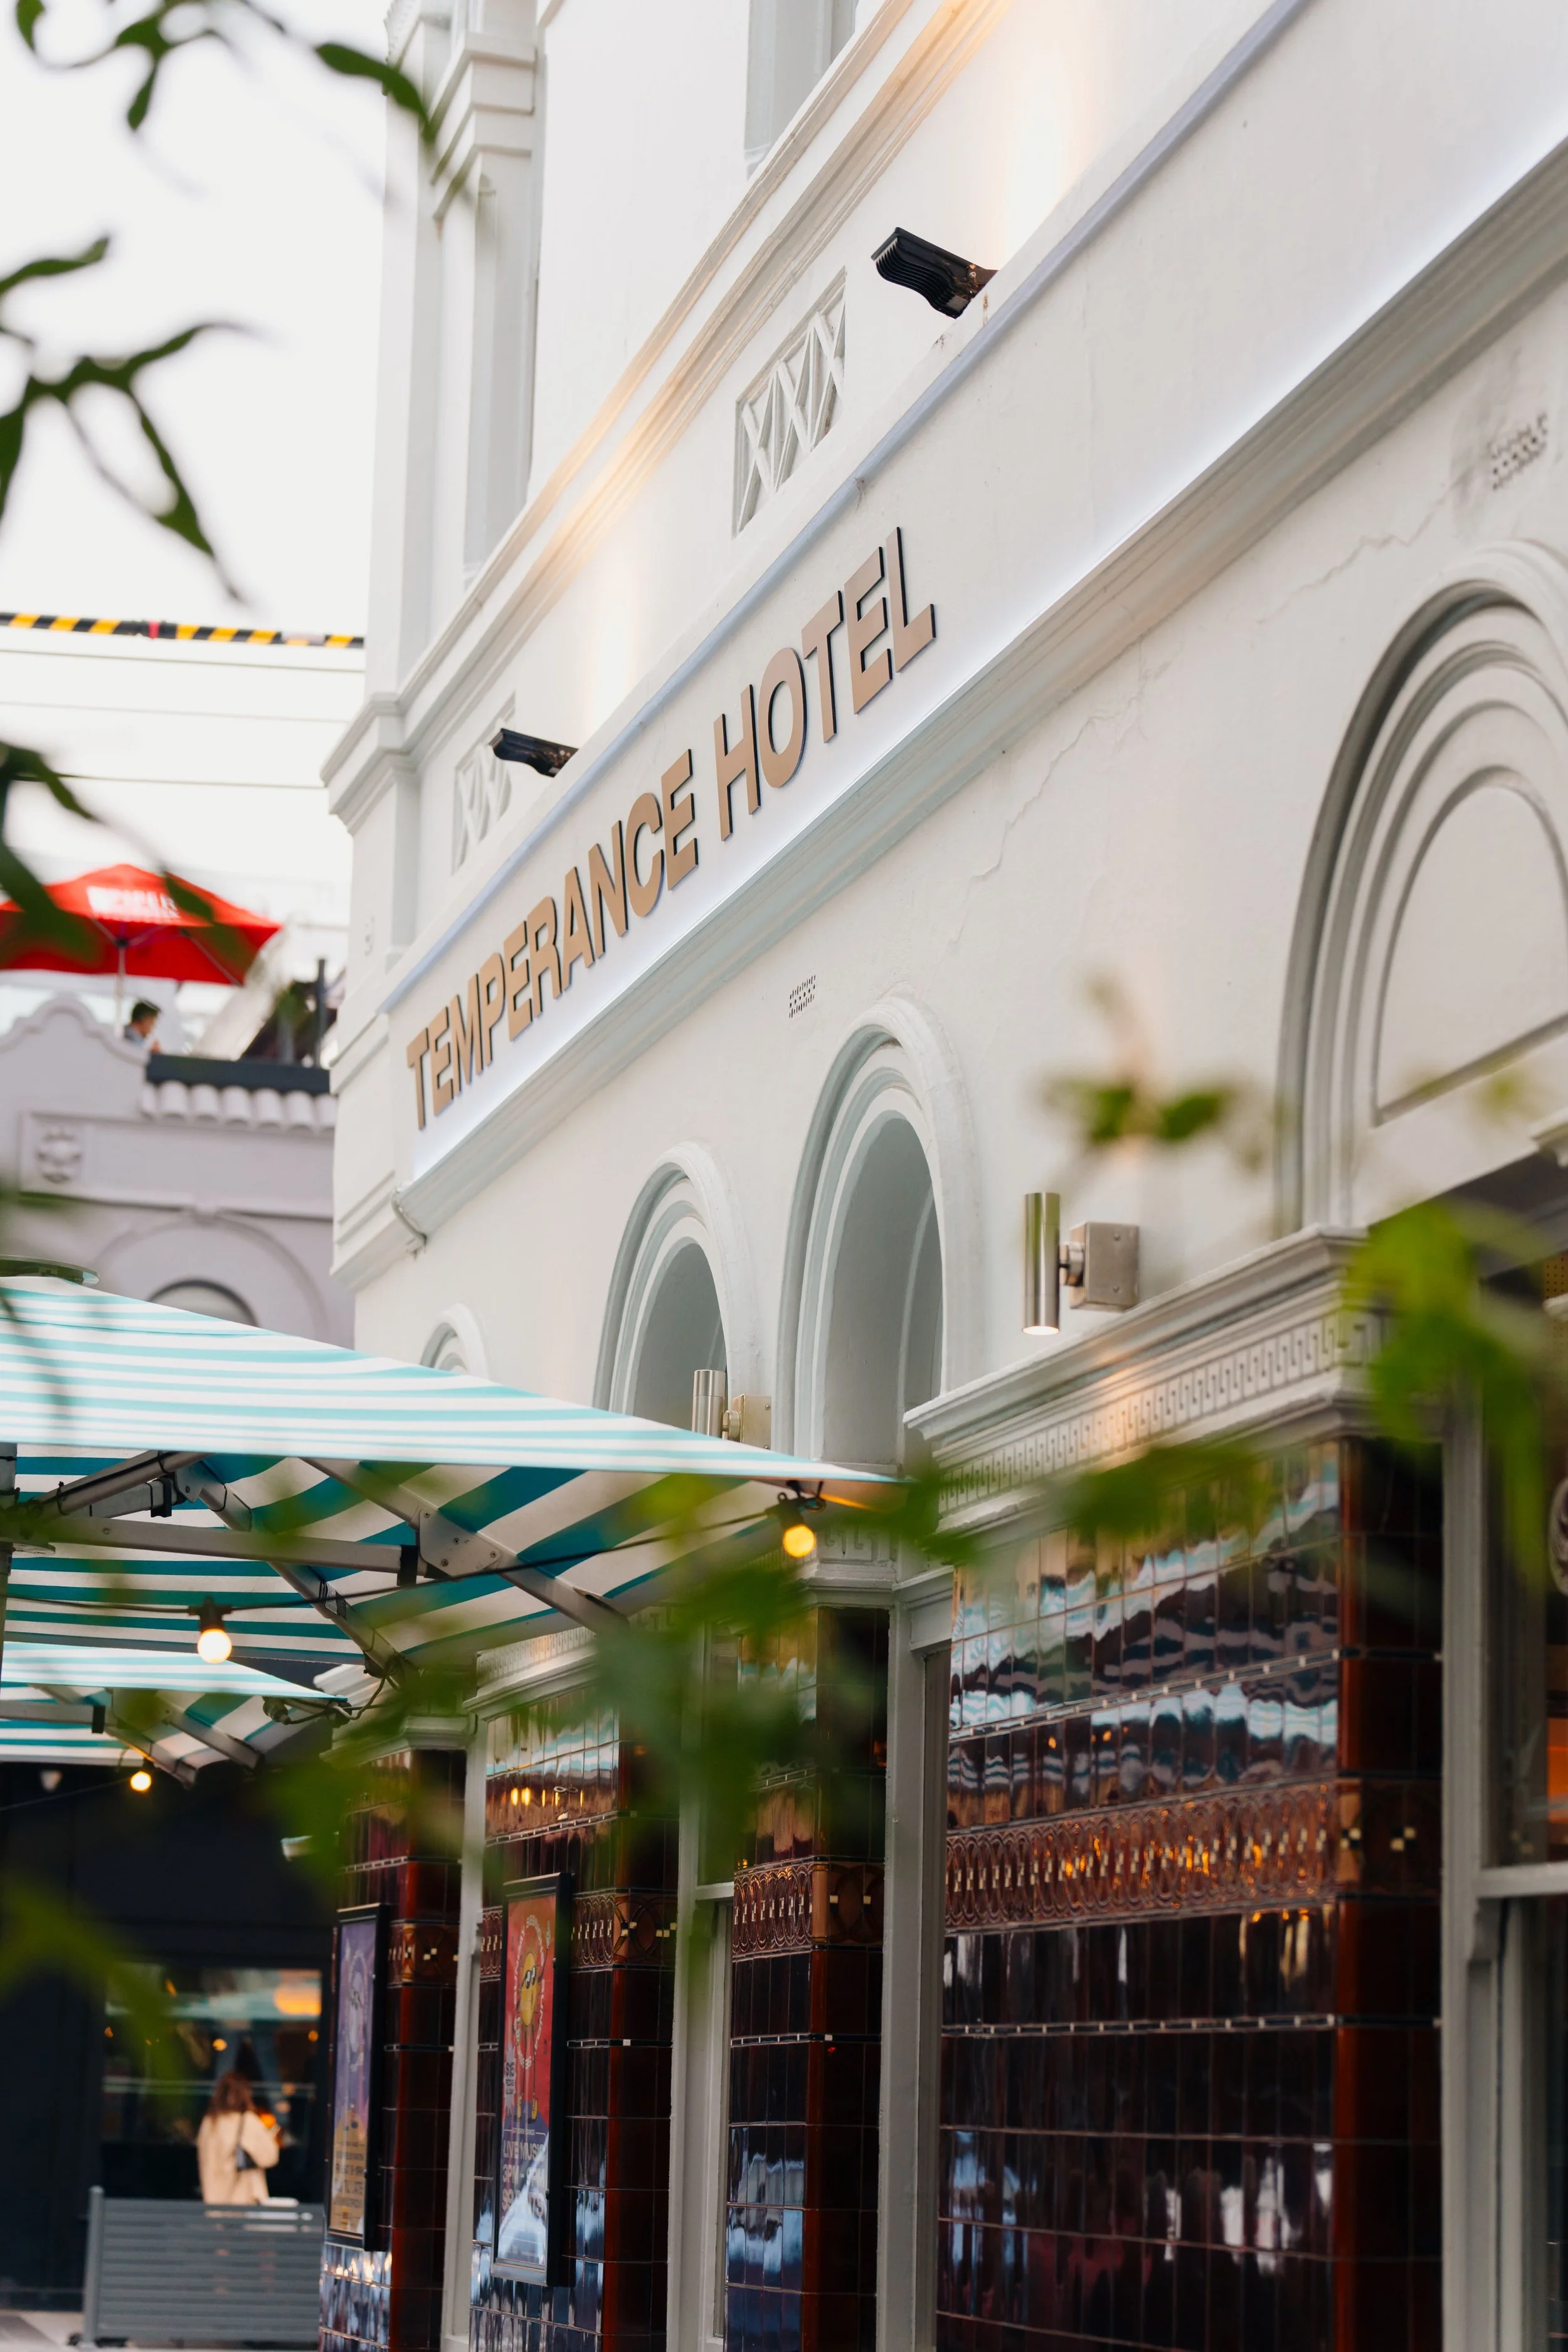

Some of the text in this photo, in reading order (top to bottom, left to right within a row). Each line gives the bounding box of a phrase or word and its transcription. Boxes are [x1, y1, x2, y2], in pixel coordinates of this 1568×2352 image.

[407, 526, 936, 1131] TEMPERANCE HOTEL
[503, 2140, 520, 2159] LIVE
[502, 2164, 519, 2186] 3PM
